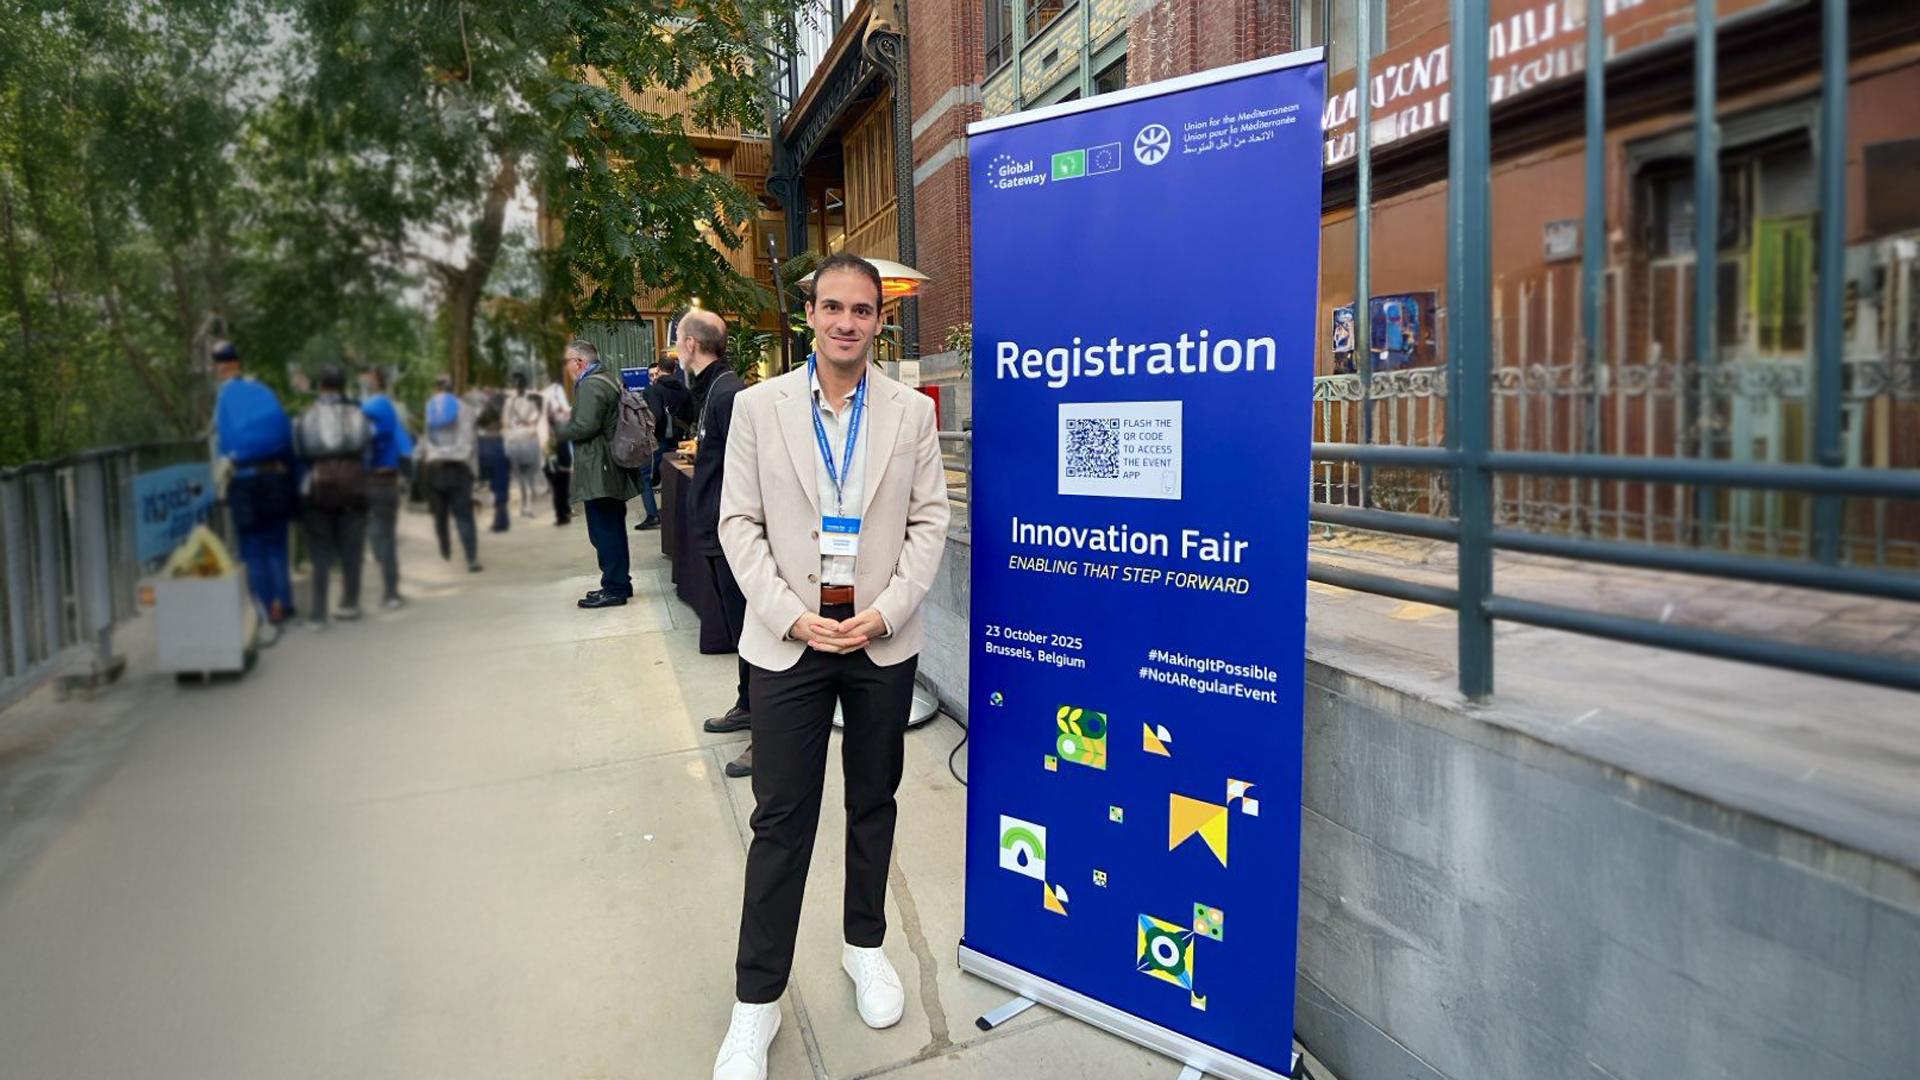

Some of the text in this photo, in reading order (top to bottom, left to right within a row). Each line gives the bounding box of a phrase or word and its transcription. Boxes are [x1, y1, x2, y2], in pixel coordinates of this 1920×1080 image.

[1184, 104, 1300, 131] Union for the Mediterranean
[1184, 116, 1297, 142] Union pour la Méditerranée
[1248, 130, 1274, 143] الاتحاد
[1183, 140, 1214, 154] المتوسط
[1234, 138, 1246, 148] من
[998, 160, 1033, 177] Global
[999, 172, 1047, 189] Gateway
[996, 329, 1277, 388] Registration
[1123, 419, 1172, 428] FLASH THE
[1123, 432, 1164, 441] QR CODE
[1123, 444, 1173, 454] TO ACCESS
[1123, 457, 1172, 468] THE EVENT
[1123, 471, 1141, 479] APP
[1011, 516, 1249, 563] Innovation Fair
[1008, 555, 1250, 595] ENABLING THAT STEP FORWARD
[985, 624, 1083, 650] 23 October 2025
[985, 641, 1086, 670] Brussels, Belgium
[1148, 648, 1278, 683] #MakingItPossible
[1139, 666, 1278, 704] #NotARegularEvent
